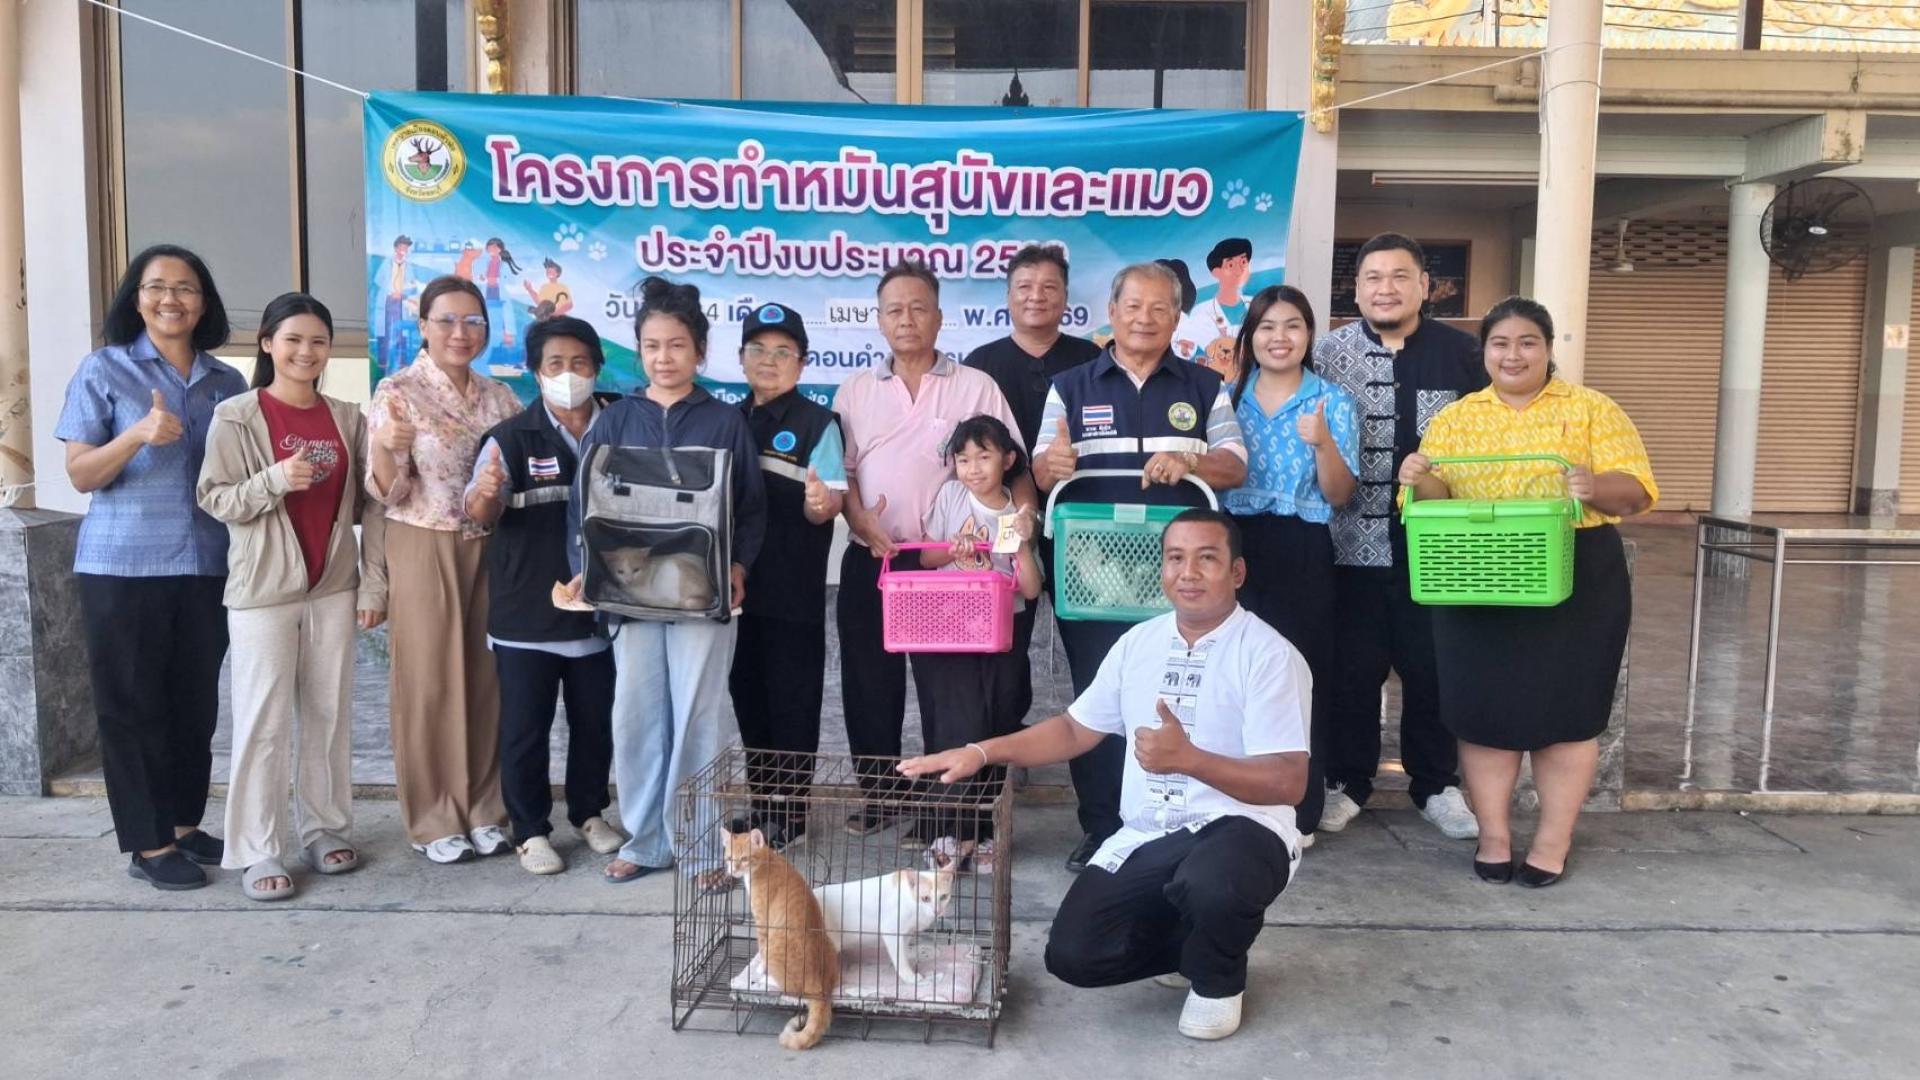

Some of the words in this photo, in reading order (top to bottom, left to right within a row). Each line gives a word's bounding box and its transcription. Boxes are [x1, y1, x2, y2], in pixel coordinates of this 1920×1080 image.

[489, 139, 1209, 230] โครงการทำหมันสุนัขและแมว
[640, 230, 964, 274] ประจำปีงบประมาณ
